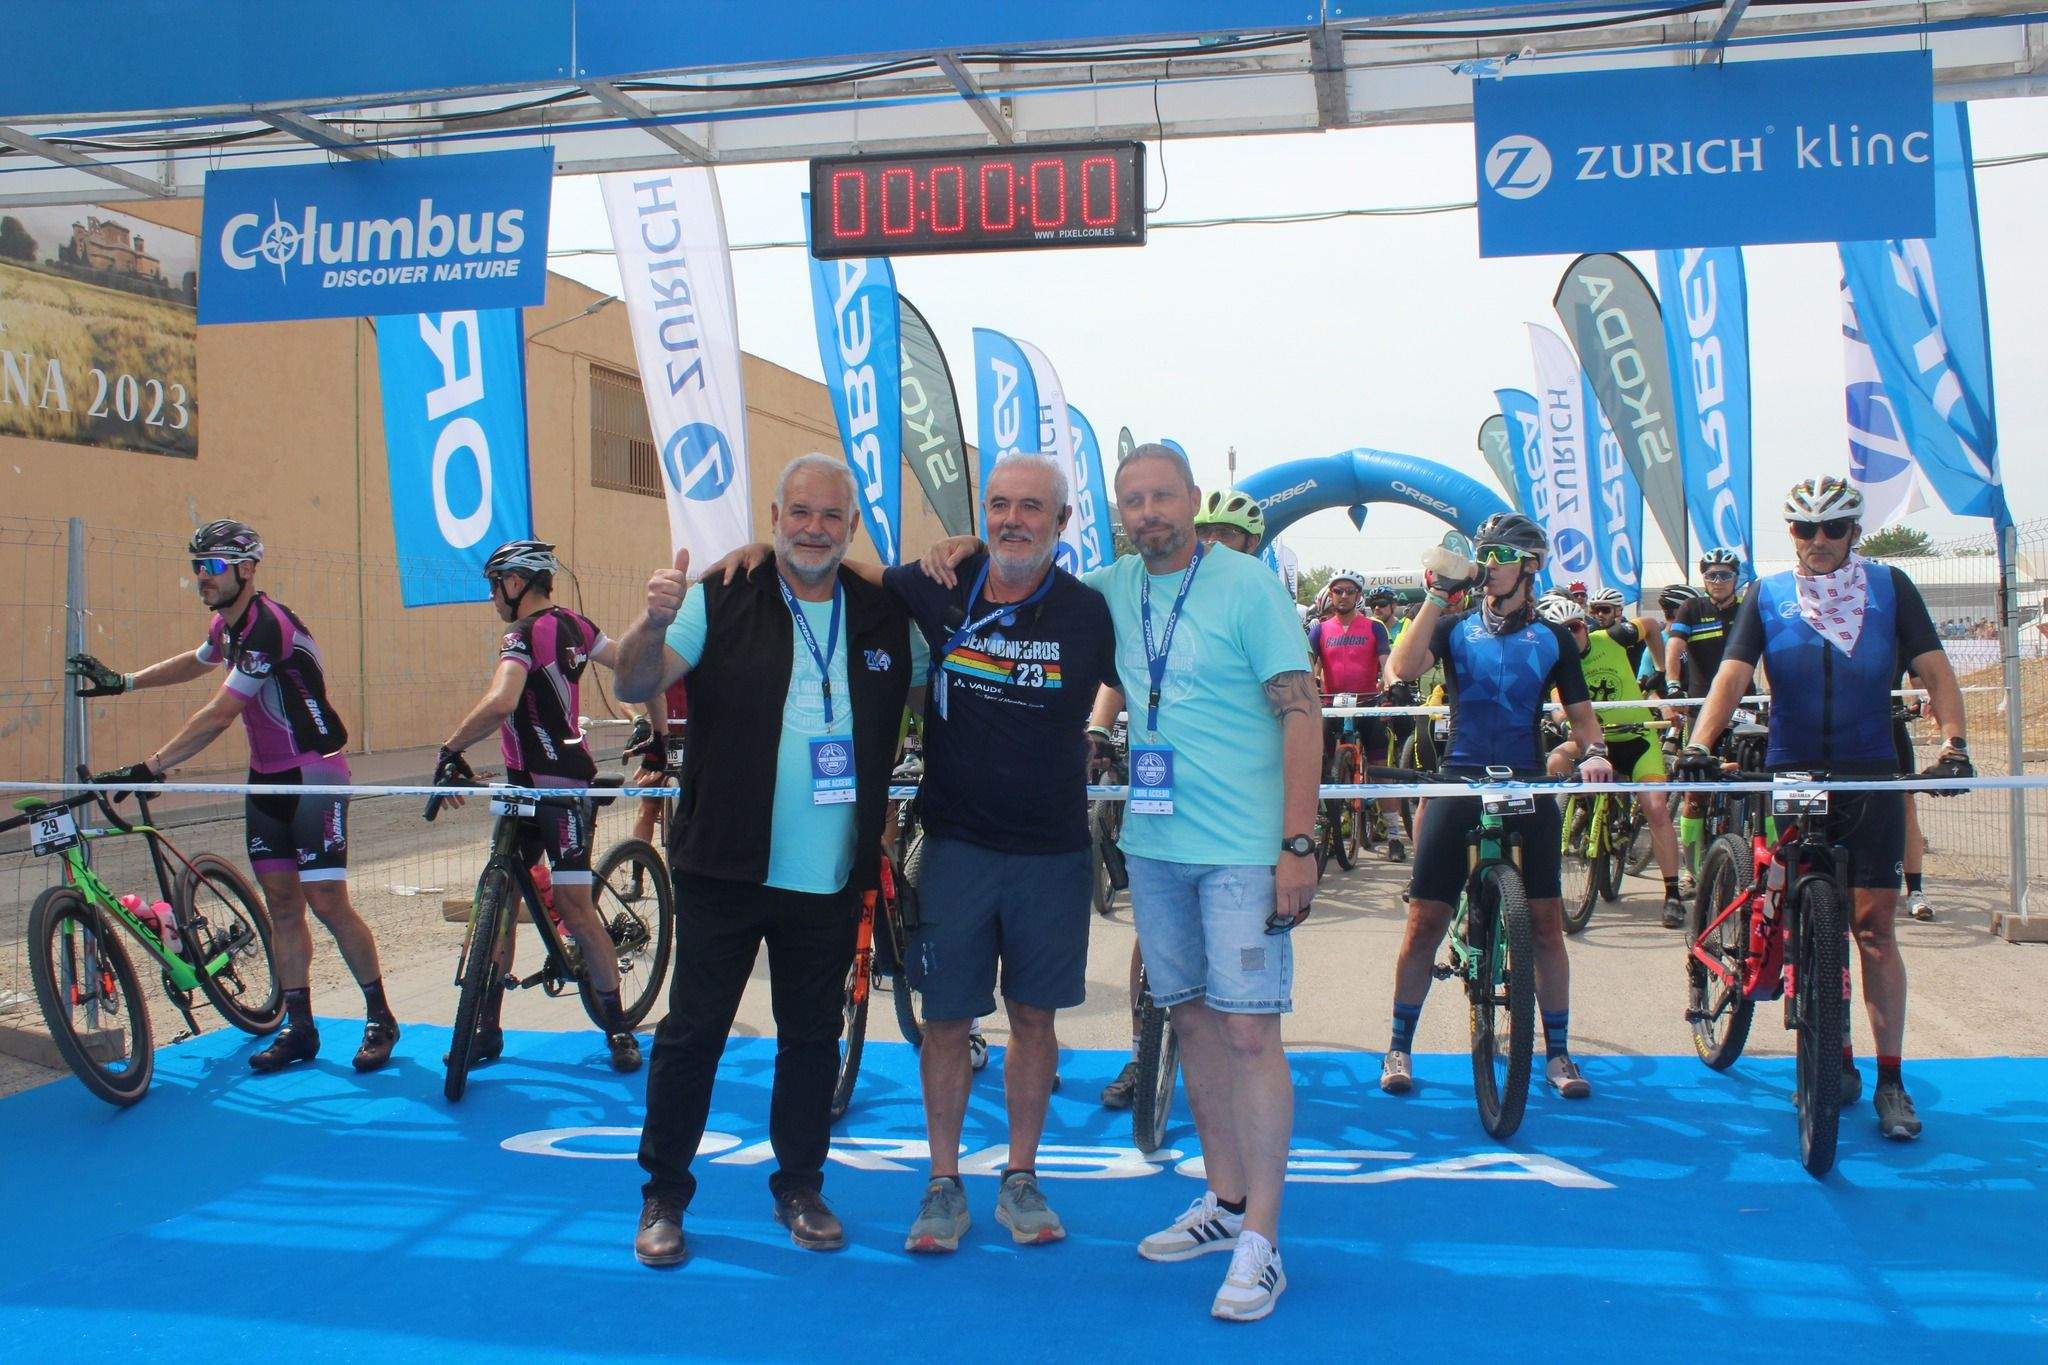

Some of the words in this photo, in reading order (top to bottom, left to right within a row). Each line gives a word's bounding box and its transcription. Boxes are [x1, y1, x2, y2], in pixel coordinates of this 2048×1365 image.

[1576, 137, 1764, 181] ZURICH
[1796, 124, 1930, 169] klinc
[221, 198, 525, 272] Columbus
[1059, 228, 1115, 239] PIXELCOM.ES
[323, 266, 427, 288] DISCOVER
[434, 259, 520, 281] NATURE
[88, 368, 189, 430] 2023
[1257, 478, 1317, 510] ORBEA
[1391, 480, 1458, 518] ORBEA
[1179, 555, 1198, 597] ORBEA
[1370, 576, 1413, 586] ZURICH
[796, 614, 816, 653] ORBEA
[1144, 619, 1156, 662] ORBEA
[1160, 612, 1177, 657] ORBEA
[1016, 663, 1044, 688] 23
[41, 818, 59, 836] 29
[504, 803, 518, 816] 28
